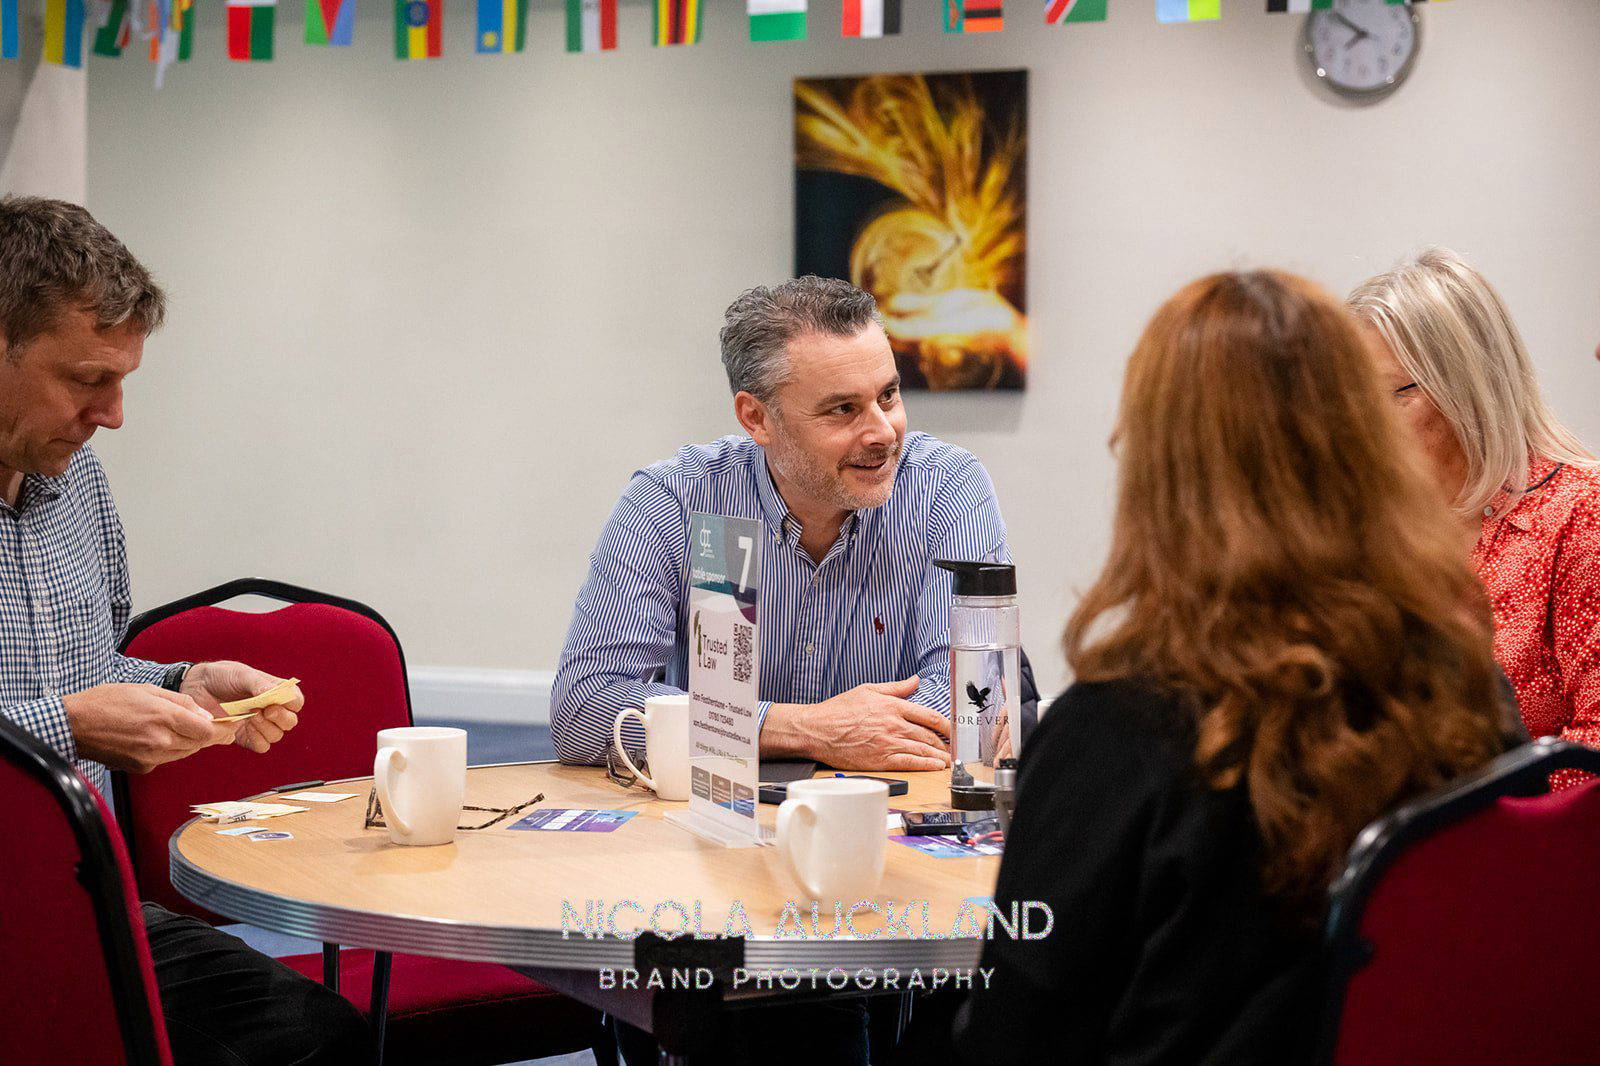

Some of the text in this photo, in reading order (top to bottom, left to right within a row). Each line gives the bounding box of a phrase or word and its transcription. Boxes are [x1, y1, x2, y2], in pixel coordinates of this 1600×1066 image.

[738, 535, 753, 593] 7
[703, 634, 728, 656] Trusted
[703, 652, 717, 670] Law
